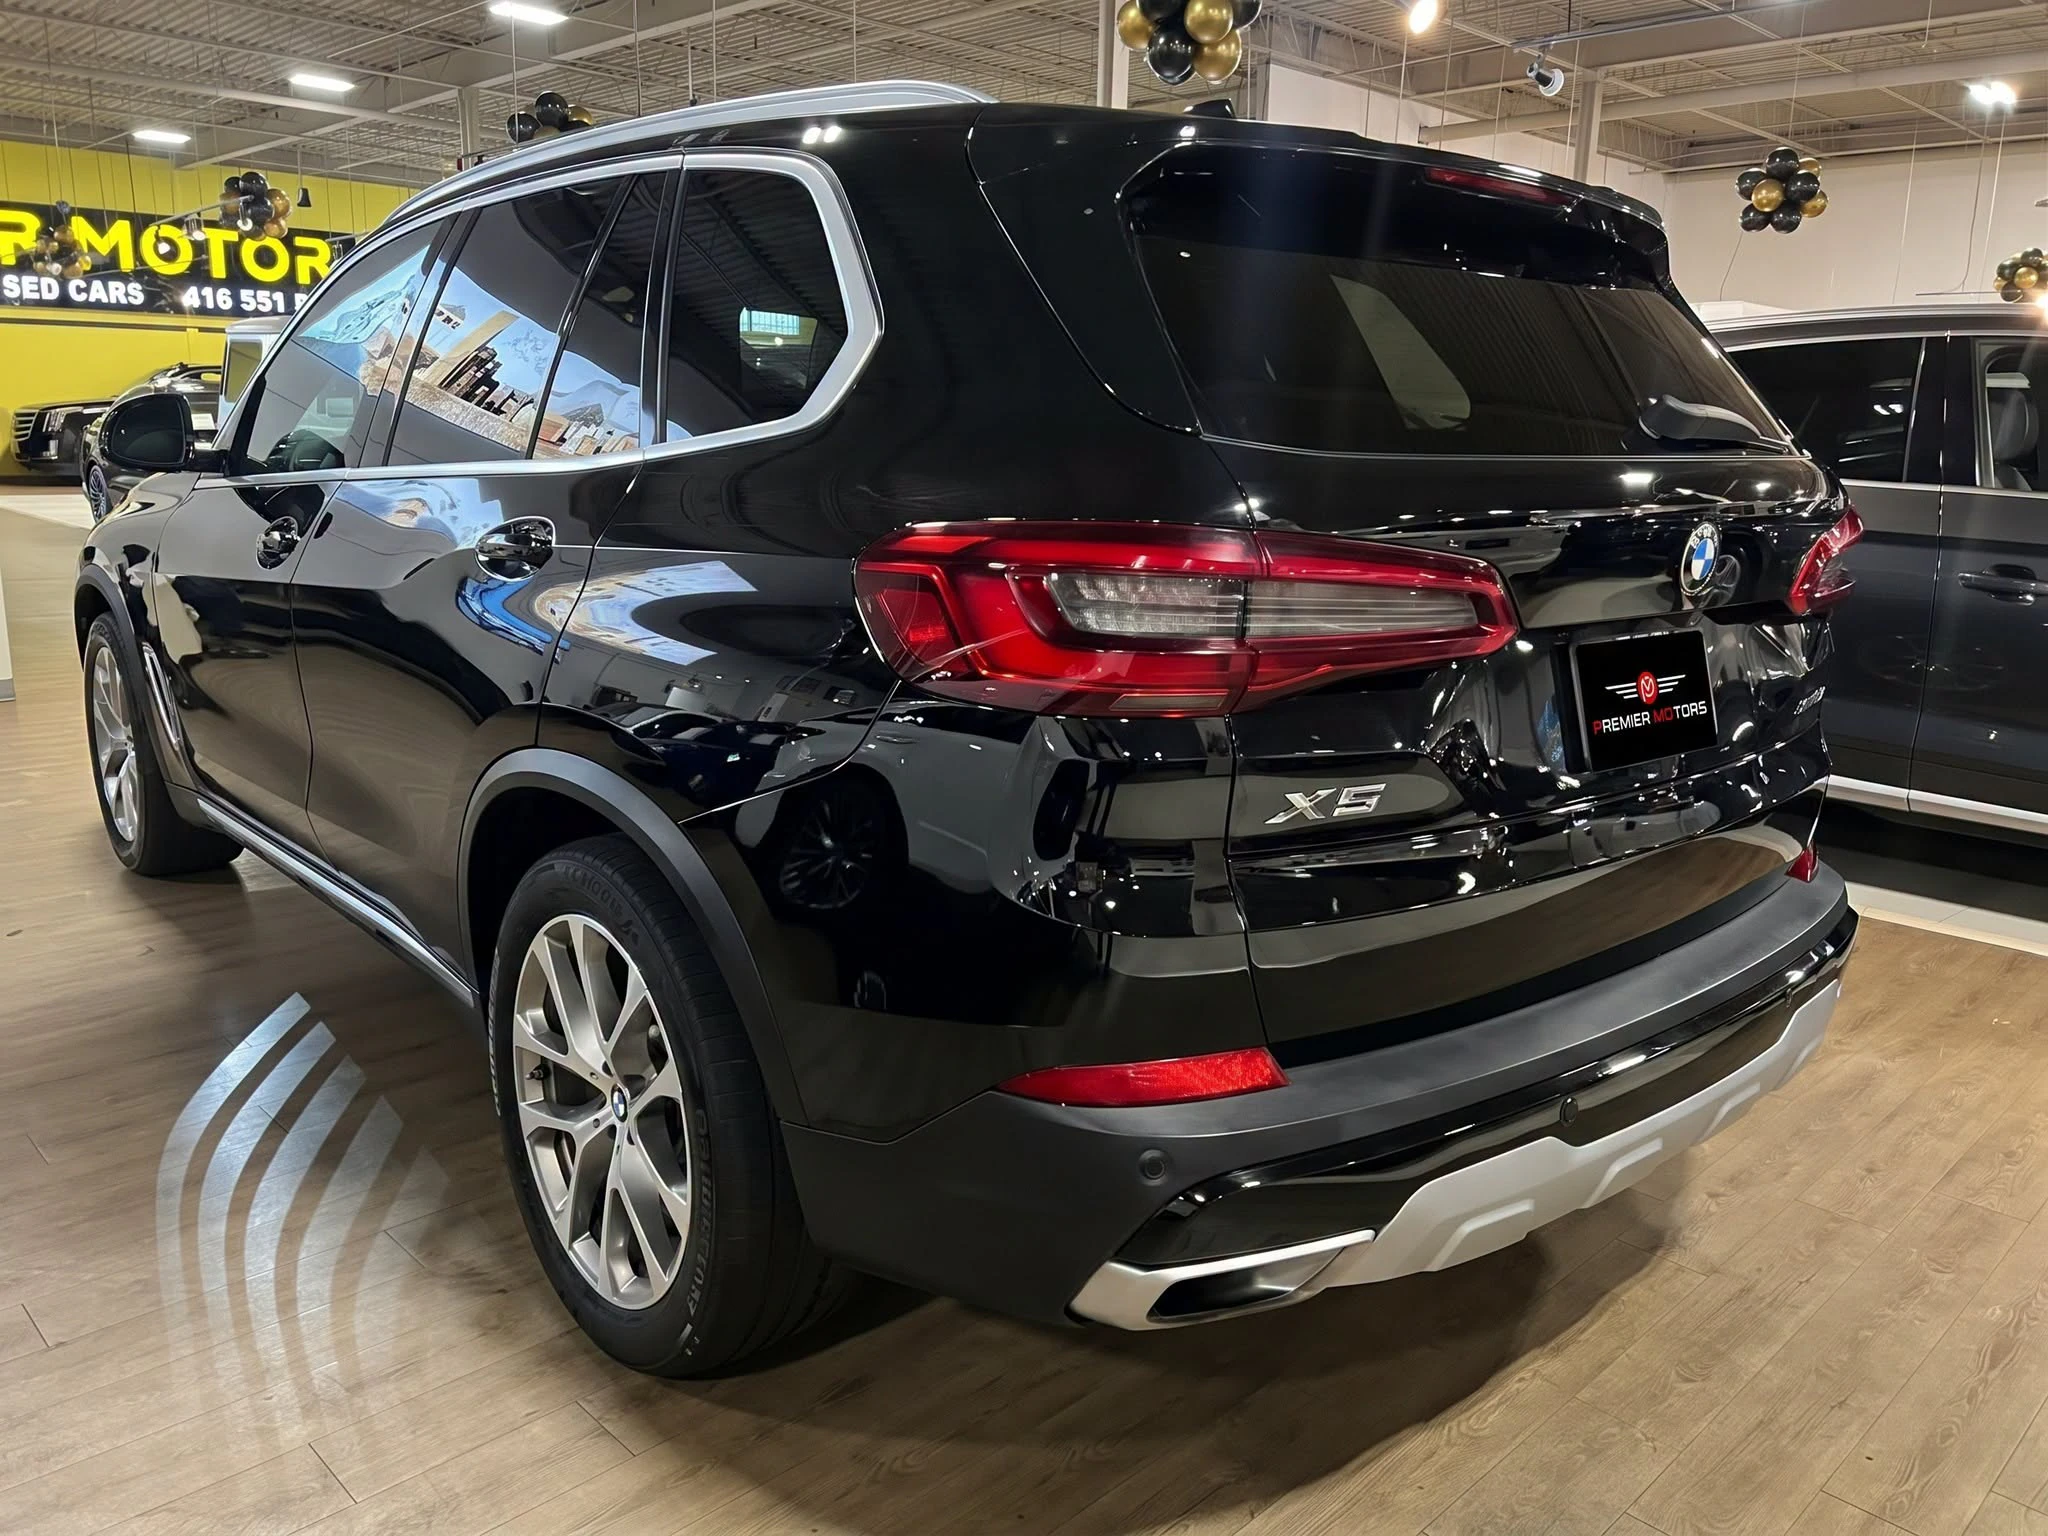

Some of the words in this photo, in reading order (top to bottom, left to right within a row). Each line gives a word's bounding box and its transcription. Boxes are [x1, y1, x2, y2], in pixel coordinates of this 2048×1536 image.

[2, 274, 60, 300] SED
[68, 278, 145, 305] CARS
[182, 286, 233, 310] 416
[240, 289, 286, 313] 551
[1592, 711, 1651, 735] PREMIER
[1653, 700, 1708, 723] MOTORS
[1264, 783, 1387, 824] X5
